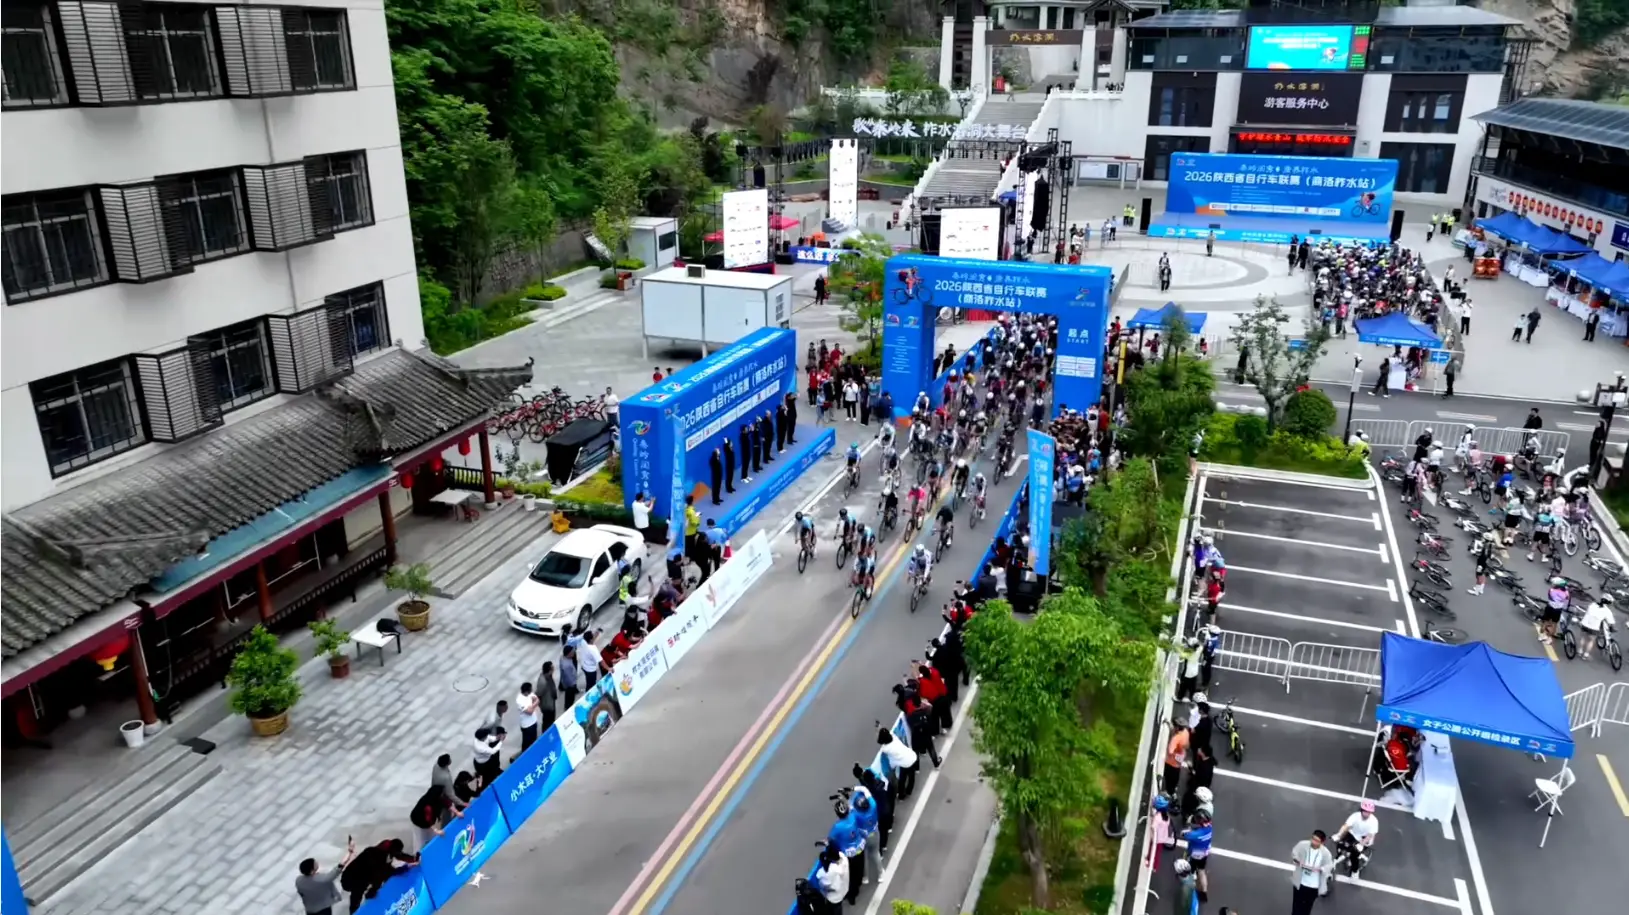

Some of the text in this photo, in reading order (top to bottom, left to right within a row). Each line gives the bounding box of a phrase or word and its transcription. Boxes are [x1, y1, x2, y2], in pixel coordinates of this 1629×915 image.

[1263, 97, 1329, 110] 游客服务中心
[934, 279, 1048, 299] 2026陕西省自行车联赛
[1068, 328, 1089, 339] 起点
[1422, 718, 1521, 746] 女子公路公开组检录区
[511, 751, 558, 802] 小木耳·大产业
